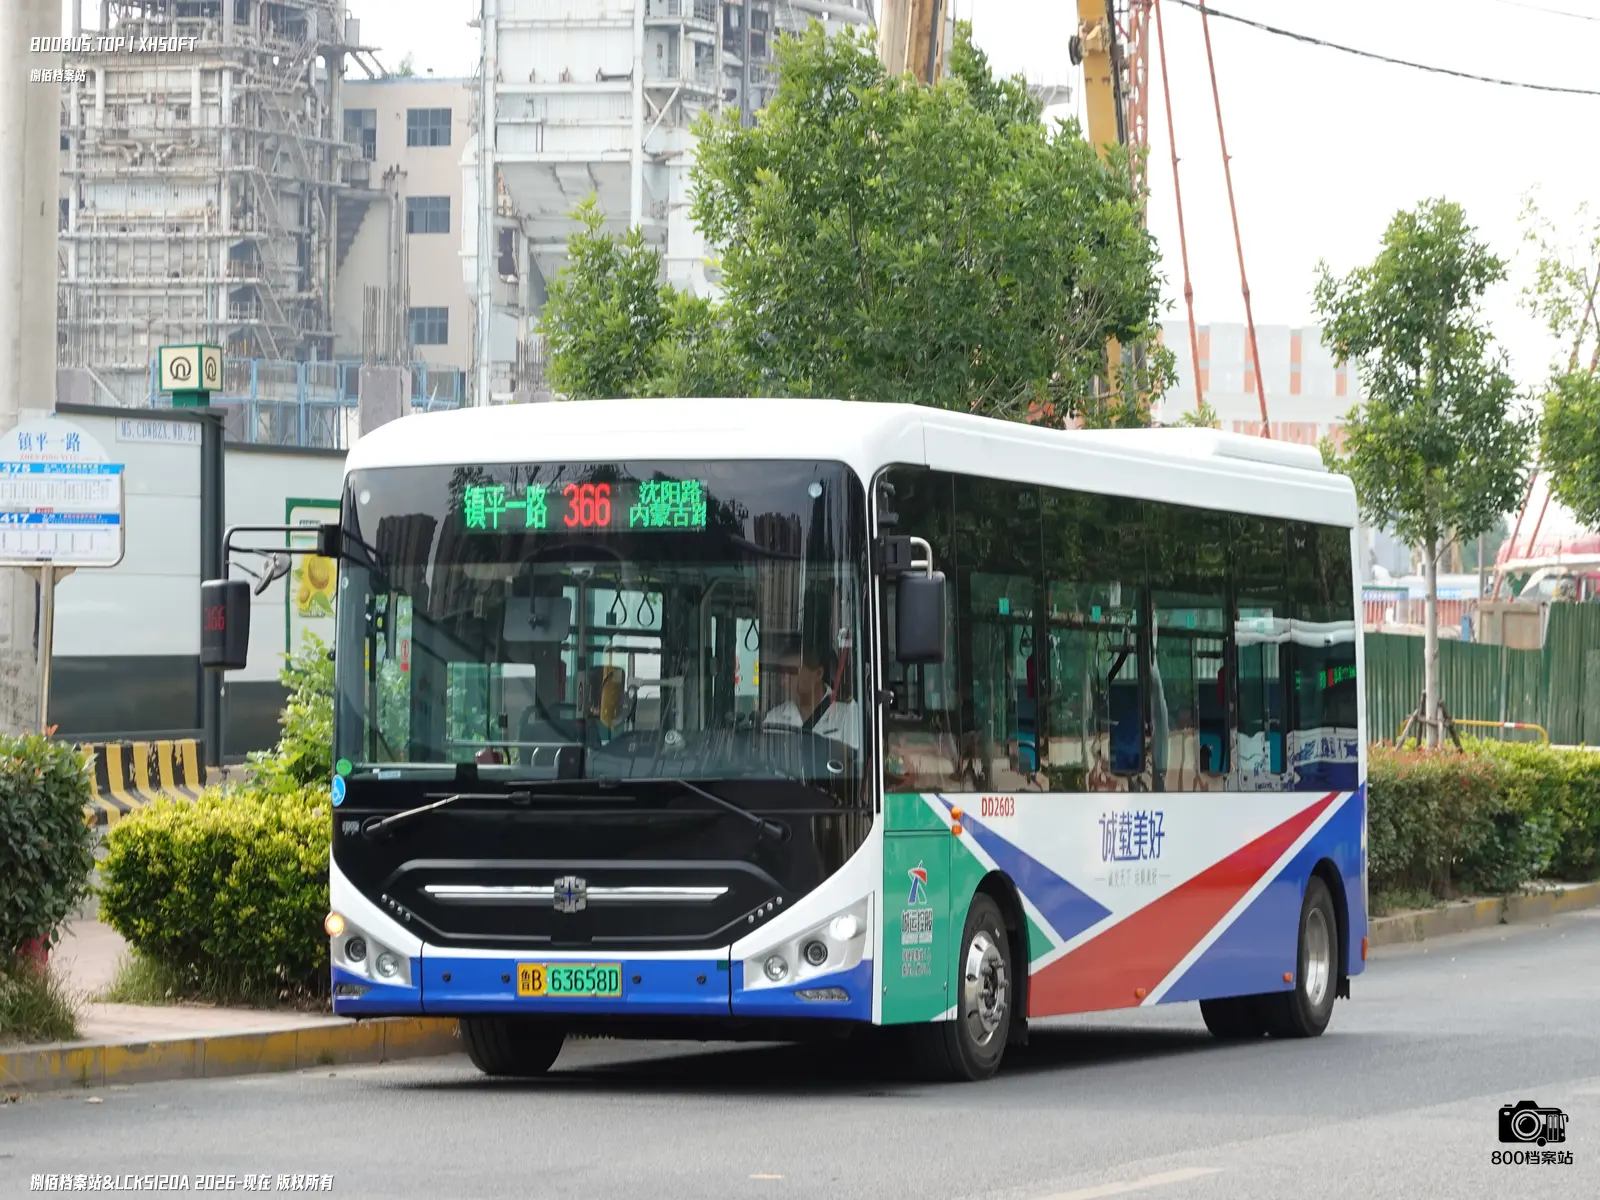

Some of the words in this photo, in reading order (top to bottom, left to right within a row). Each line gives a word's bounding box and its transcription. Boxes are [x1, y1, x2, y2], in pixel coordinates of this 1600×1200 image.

[18, 431, 81, 452] 镇平一路
[638, 480, 702, 503] 沈阳路
[464, 484, 548, 529] 镇平一路
[563, 483, 611, 527] 366
[629, 501, 707, 528] 内蒙古路
[0, 513, 30, 524] 417
[981, 796, 1015, 817] DD2603
[1098, 810, 1166, 862] 诚载美好
